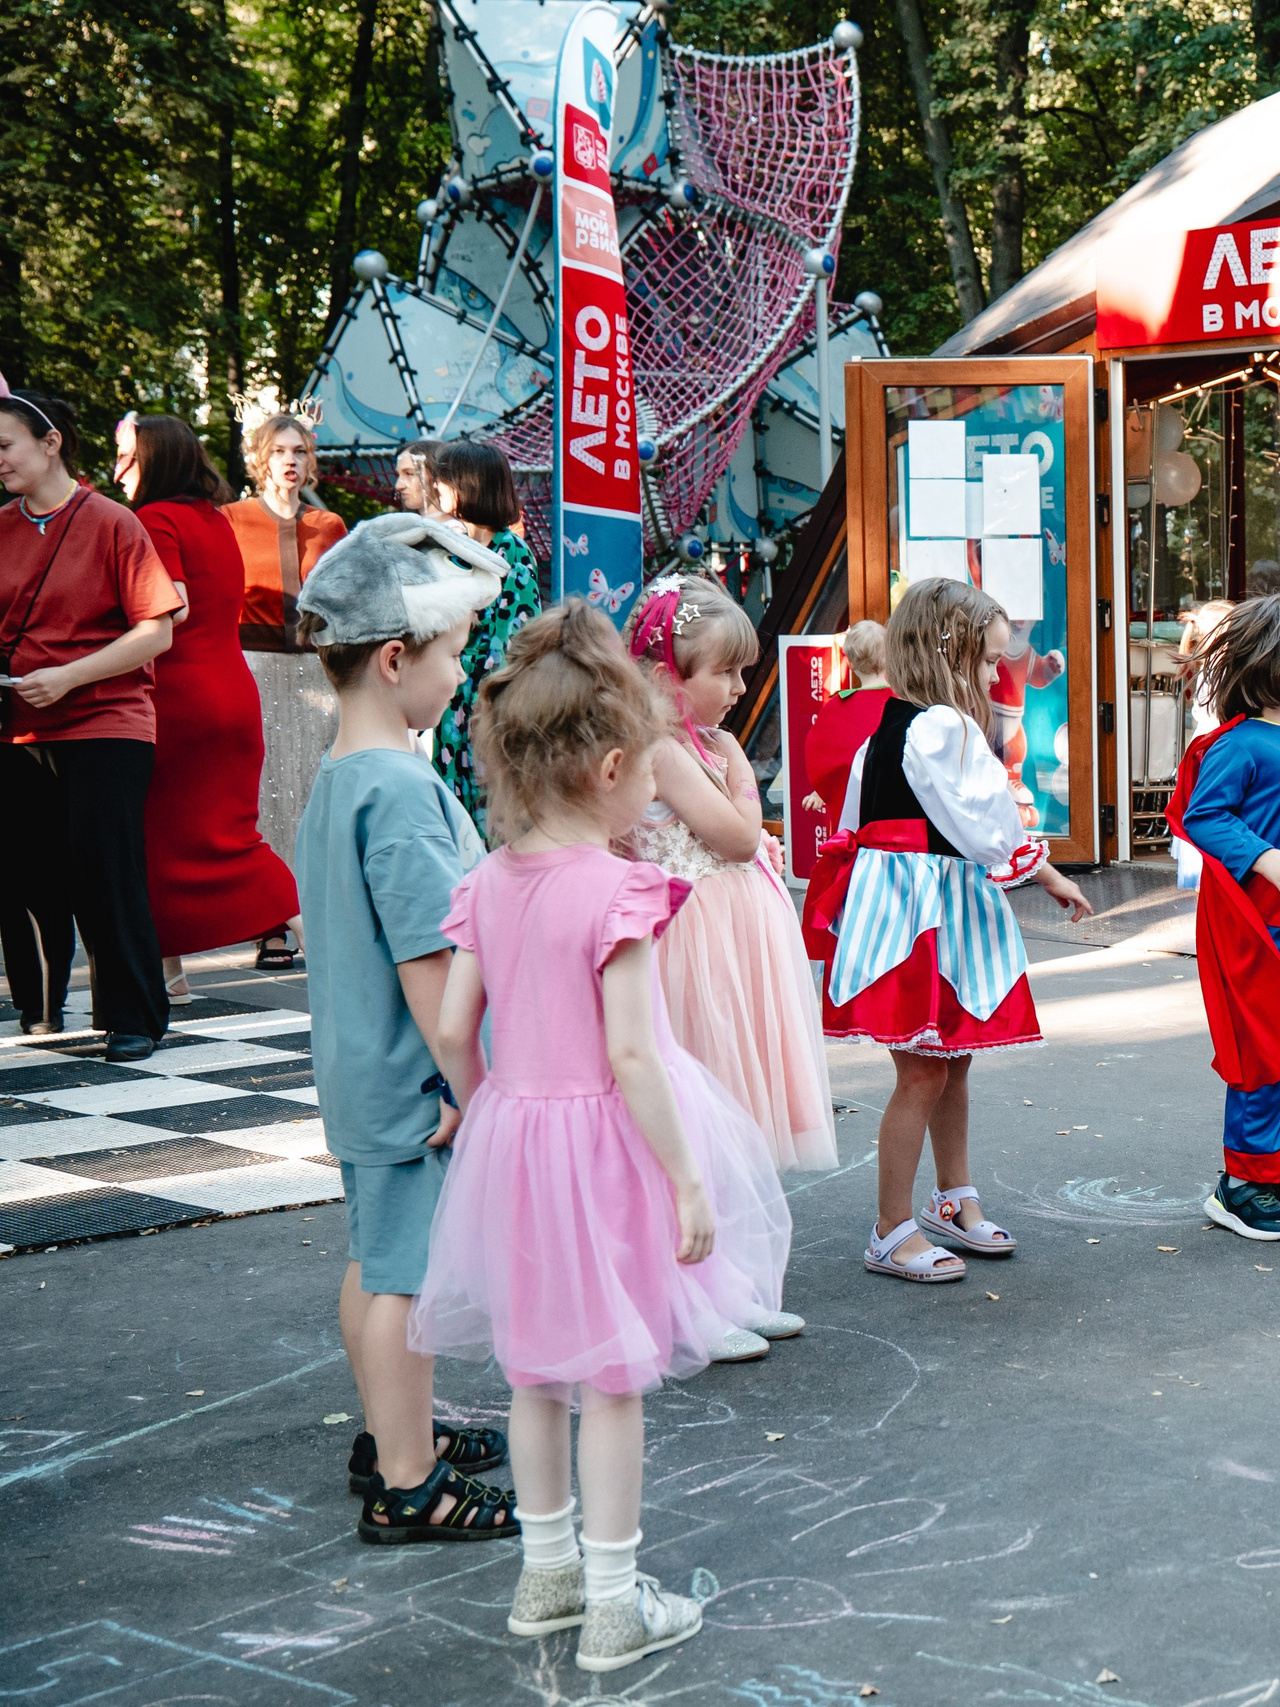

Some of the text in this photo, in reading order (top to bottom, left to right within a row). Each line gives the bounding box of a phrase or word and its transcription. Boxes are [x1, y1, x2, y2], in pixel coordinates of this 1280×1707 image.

[569, 305, 611, 476] ЛЕТО
[613, 313, 631, 480] В МОСКВЕ
[1202, 303, 1224, 332] В
